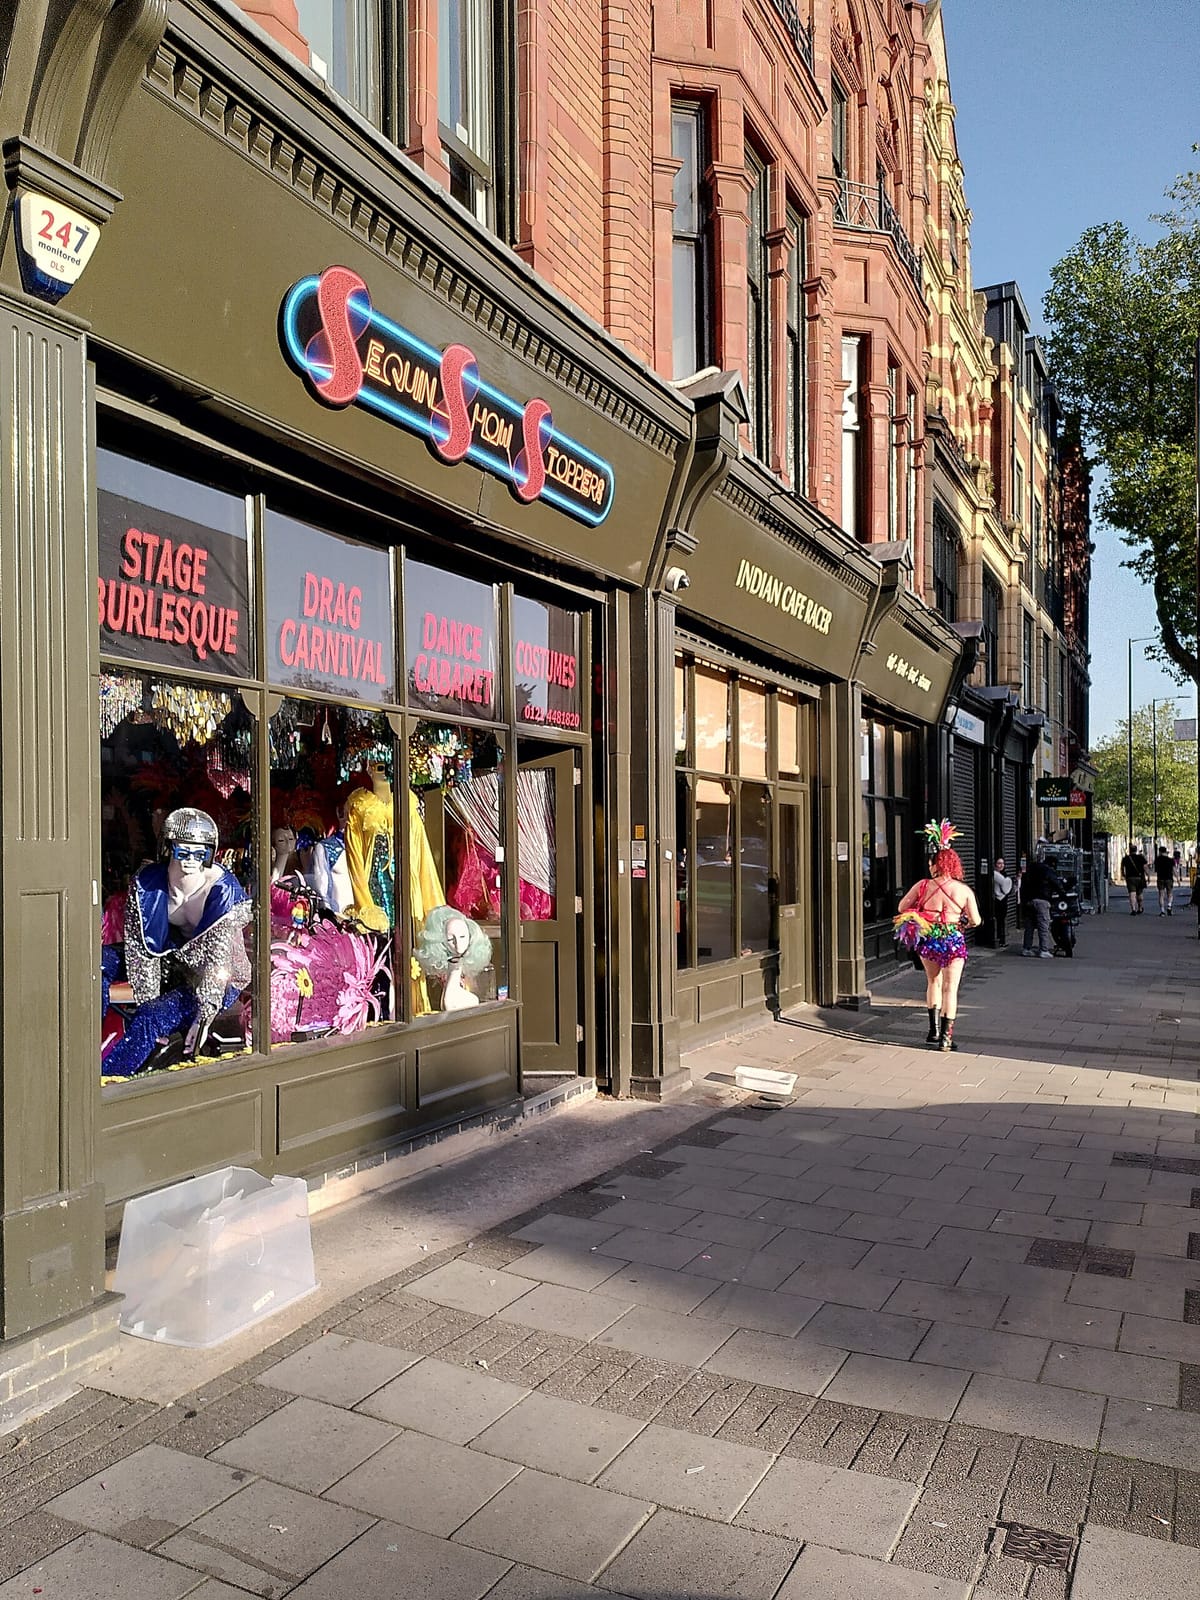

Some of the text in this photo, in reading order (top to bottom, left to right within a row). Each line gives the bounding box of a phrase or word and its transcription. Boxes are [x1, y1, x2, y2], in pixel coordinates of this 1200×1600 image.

[38, 241, 81, 266] monitored
[122, 527, 208, 596] STAGE
[303, 571, 363, 631] DRAG
[735, 559, 833, 635] INDIAN CAFE RACER
[280, 619, 386, 684] CARNIVAL
[423, 612, 484, 663] DANCE
[415, 654, 495, 705] CABARET
[515, 639, 577, 688] COSTUMES
[524, 704, 580, 728] 0121 4481820
